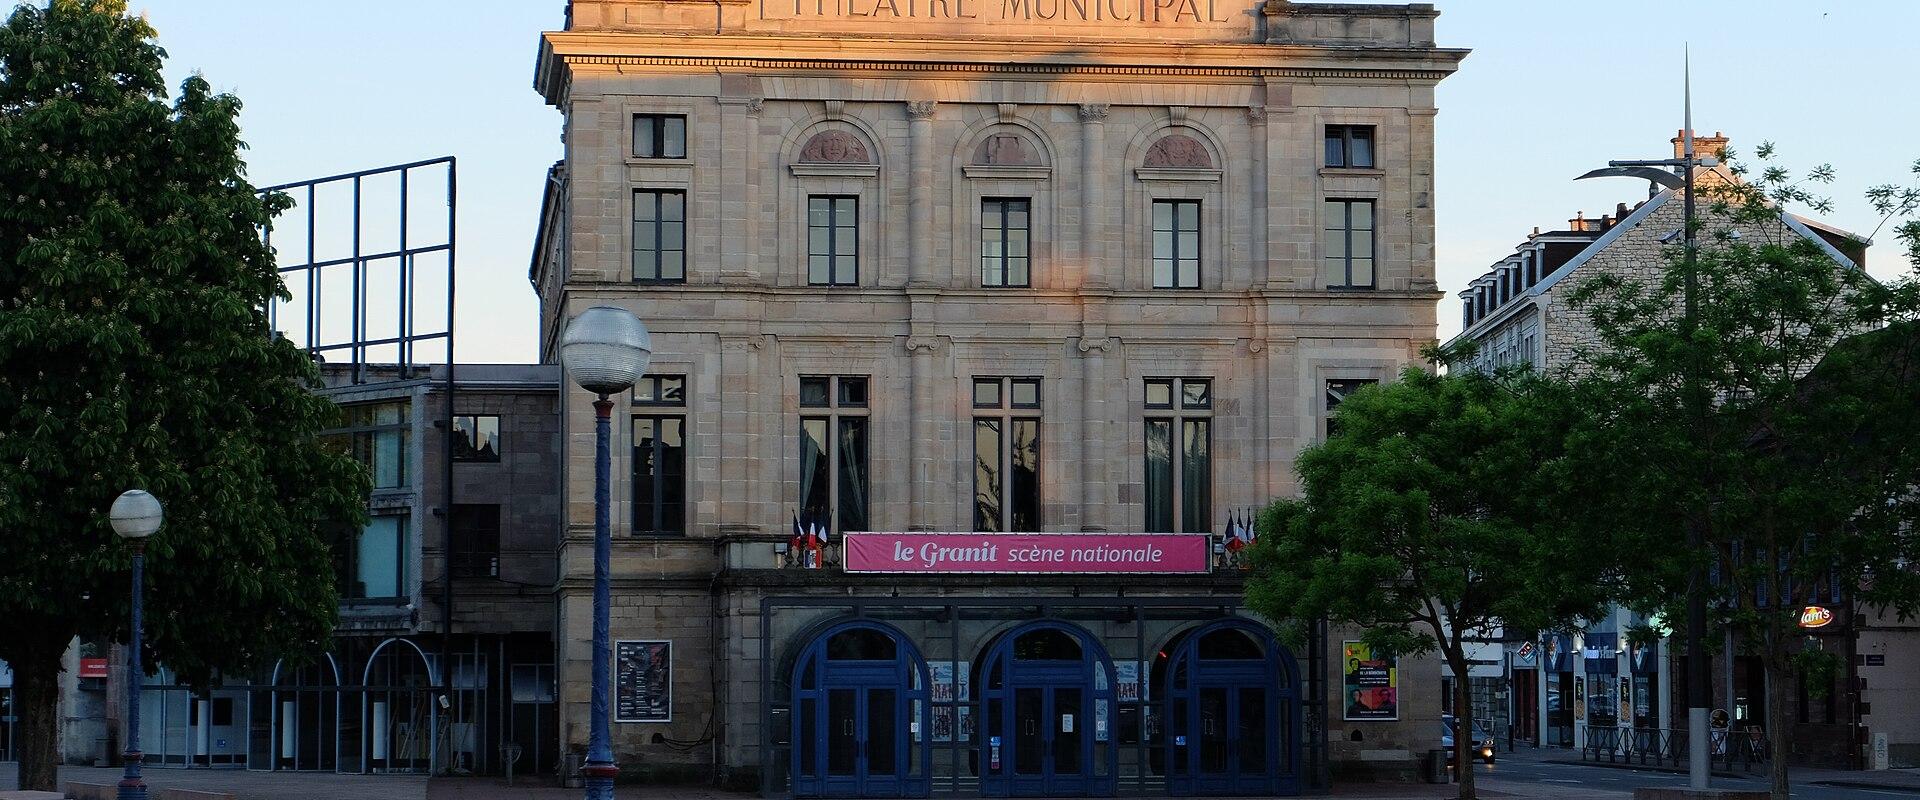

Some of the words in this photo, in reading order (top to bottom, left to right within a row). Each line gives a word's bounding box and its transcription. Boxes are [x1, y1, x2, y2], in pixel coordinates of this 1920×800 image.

[1001, 0, 1230, 23] MUNICIPAL
[893, 540, 915, 562] le
[920, 541, 999, 568] Granit
[1007, 544, 1065, 563] scène
[1070, 543, 1163, 563] nationale
